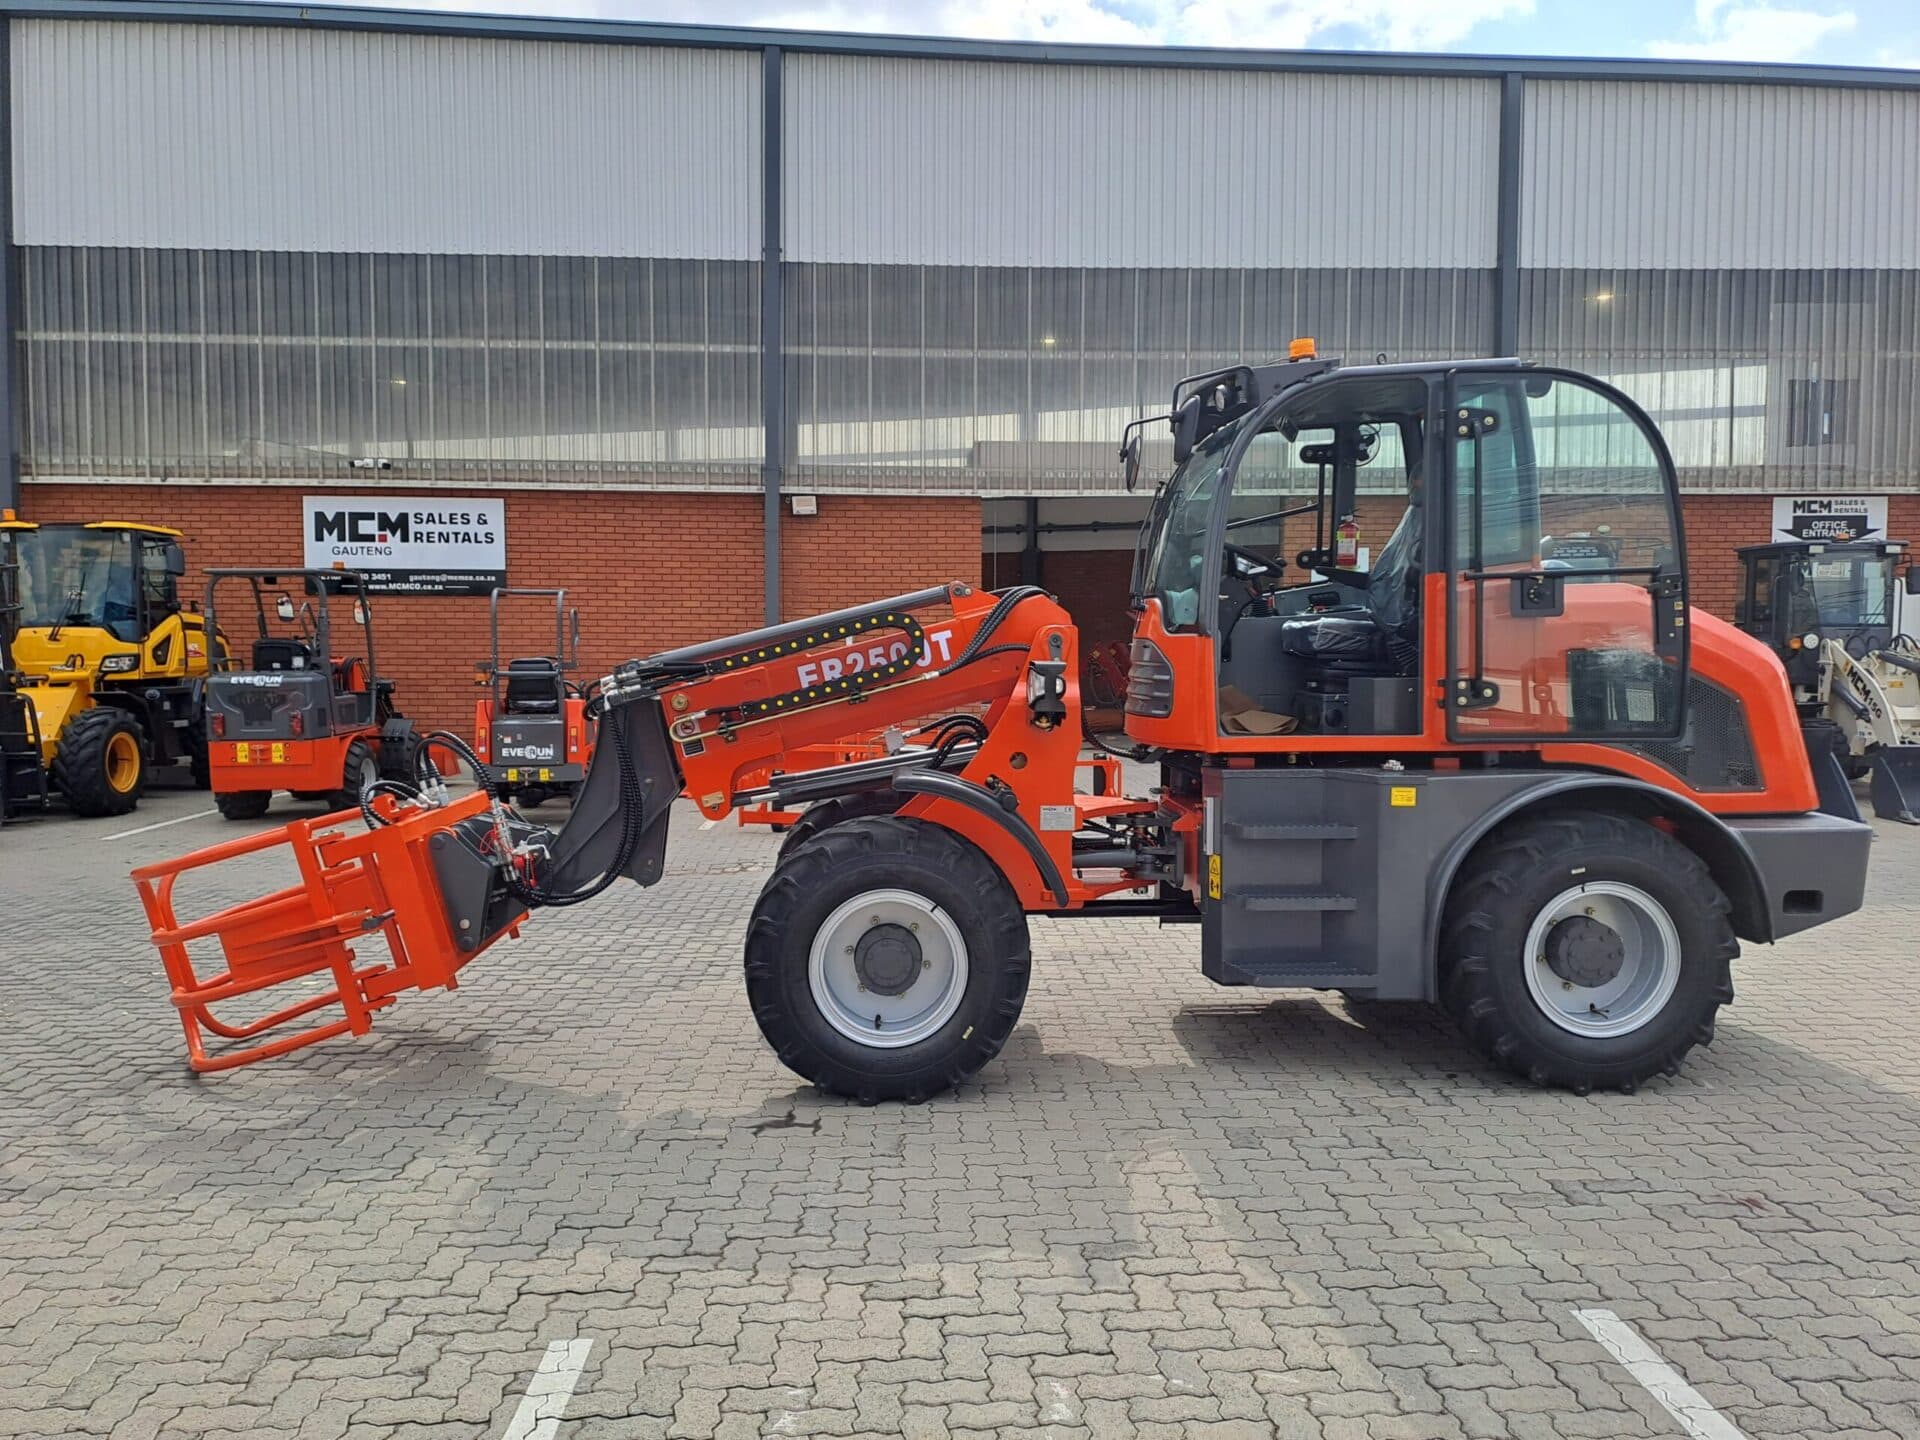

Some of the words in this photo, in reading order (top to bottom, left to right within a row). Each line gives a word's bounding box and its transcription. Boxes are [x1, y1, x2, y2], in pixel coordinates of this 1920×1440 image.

[1793, 500, 1833, 513] MCM
[413, 512, 471, 525] SALES
[477, 513, 488, 525] &
[1811, 520, 1848, 529] OFFICE
[314, 511, 410, 543] MCM
[413, 531, 495, 544] RENTALS
[331, 545, 393, 556] GAUTENG
[367, 582, 443, 590] www.MCMCO.co.za
